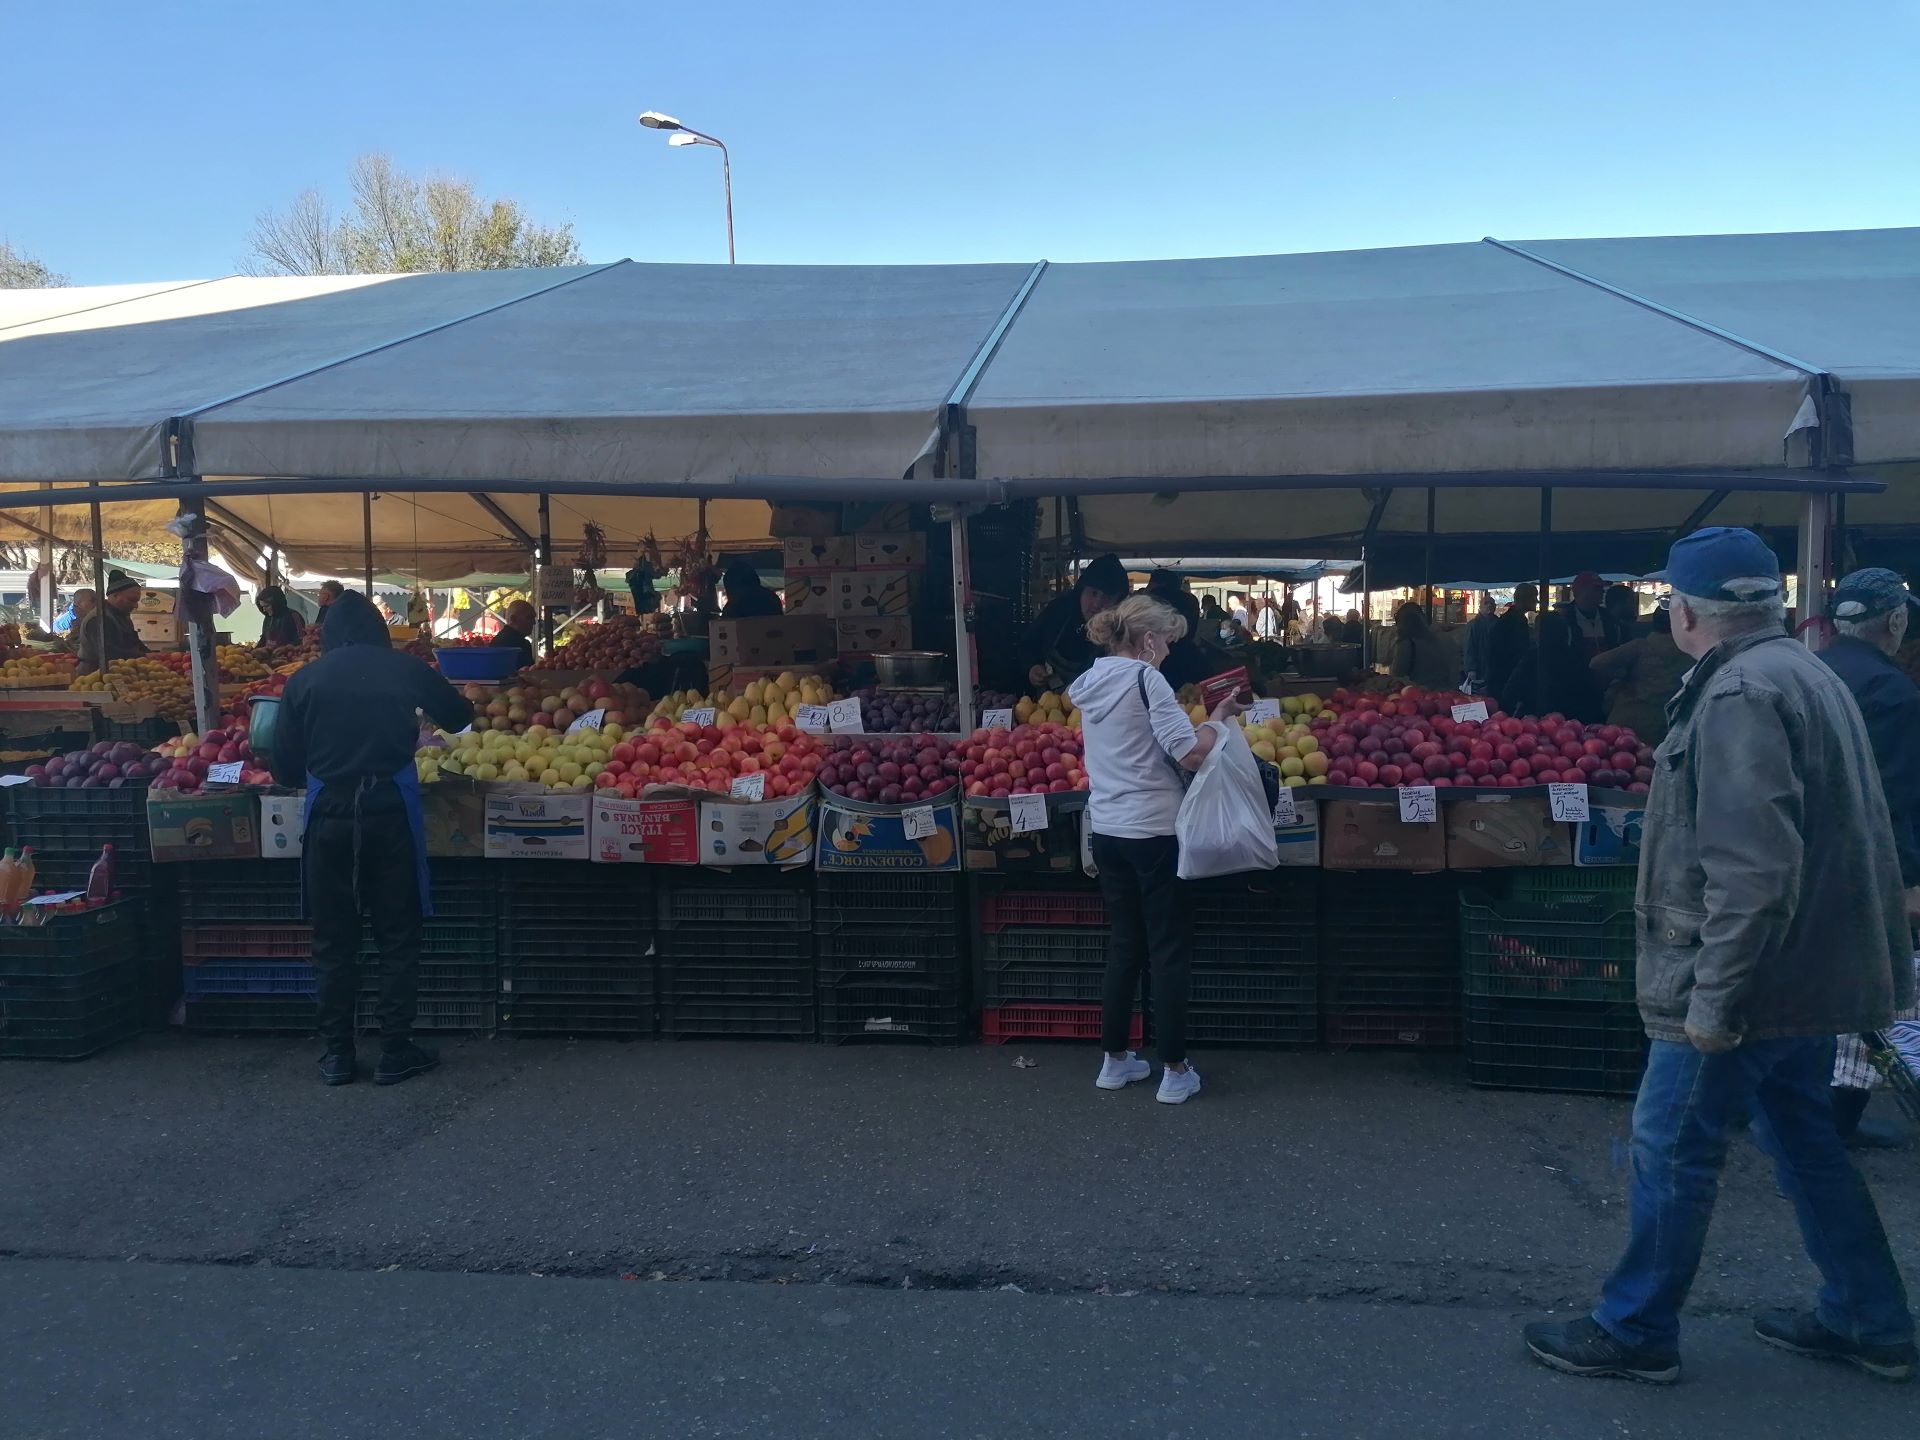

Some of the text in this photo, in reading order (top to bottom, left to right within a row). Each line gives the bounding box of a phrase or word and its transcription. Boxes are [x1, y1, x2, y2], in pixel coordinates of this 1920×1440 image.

[833, 706, 845, 723] 8
[1405, 799, 1420, 821] 5
[1555, 795, 1566, 818] 5
[613, 813, 671, 823] BANANAS
[909, 817, 918, 836] 5
[1015, 808, 1027, 830] 4
[621, 824, 663, 835] ITACU
[827, 853, 923, 867] GOLDENFORCE
